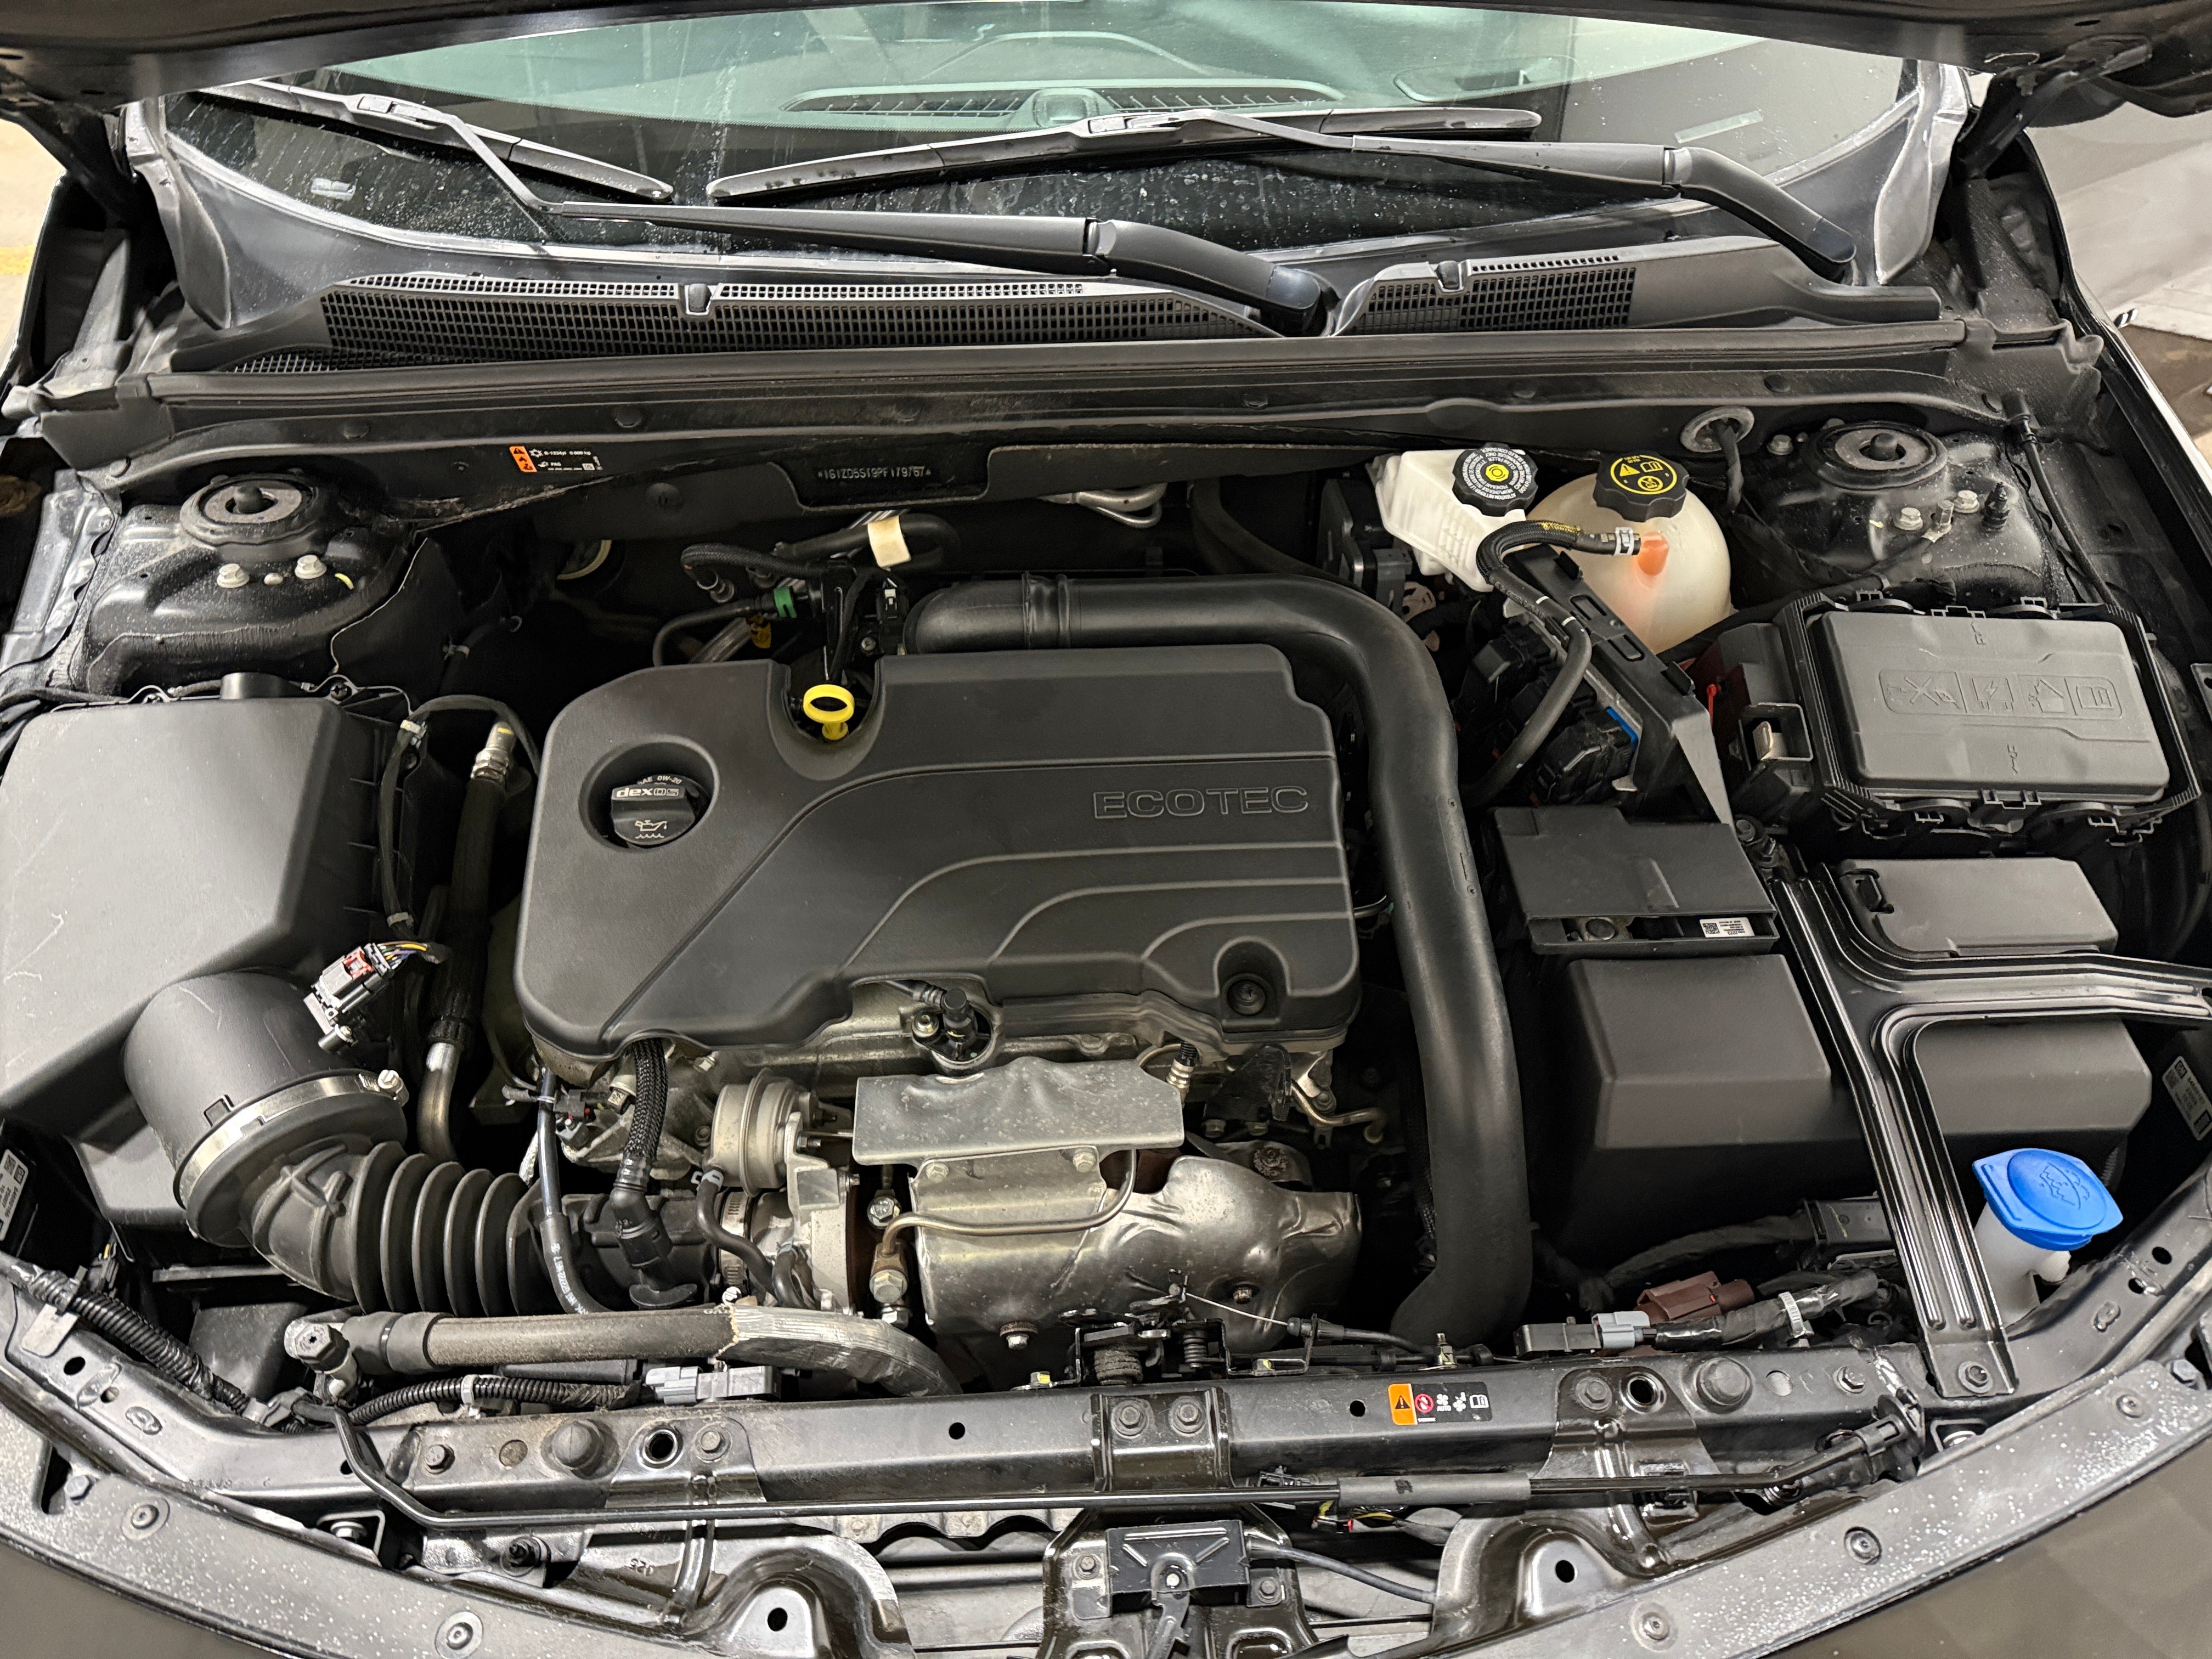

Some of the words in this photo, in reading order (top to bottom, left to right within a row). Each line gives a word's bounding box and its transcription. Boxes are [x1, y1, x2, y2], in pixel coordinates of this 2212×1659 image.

[1504, 454, 1524, 470] REMOVING
[1506, 450, 1524, 462] SEALED
[1503, 459, 1516, 470] CLEAN
[1521, 462, 1531, 474] FROM
[1474, 487, 1494, 499] NETTOYER
[657, 775, 682, 785] 0W-20
[616, 787, 679, 798] dexos
[1093, 785, 1309, 819] ECOTEC
